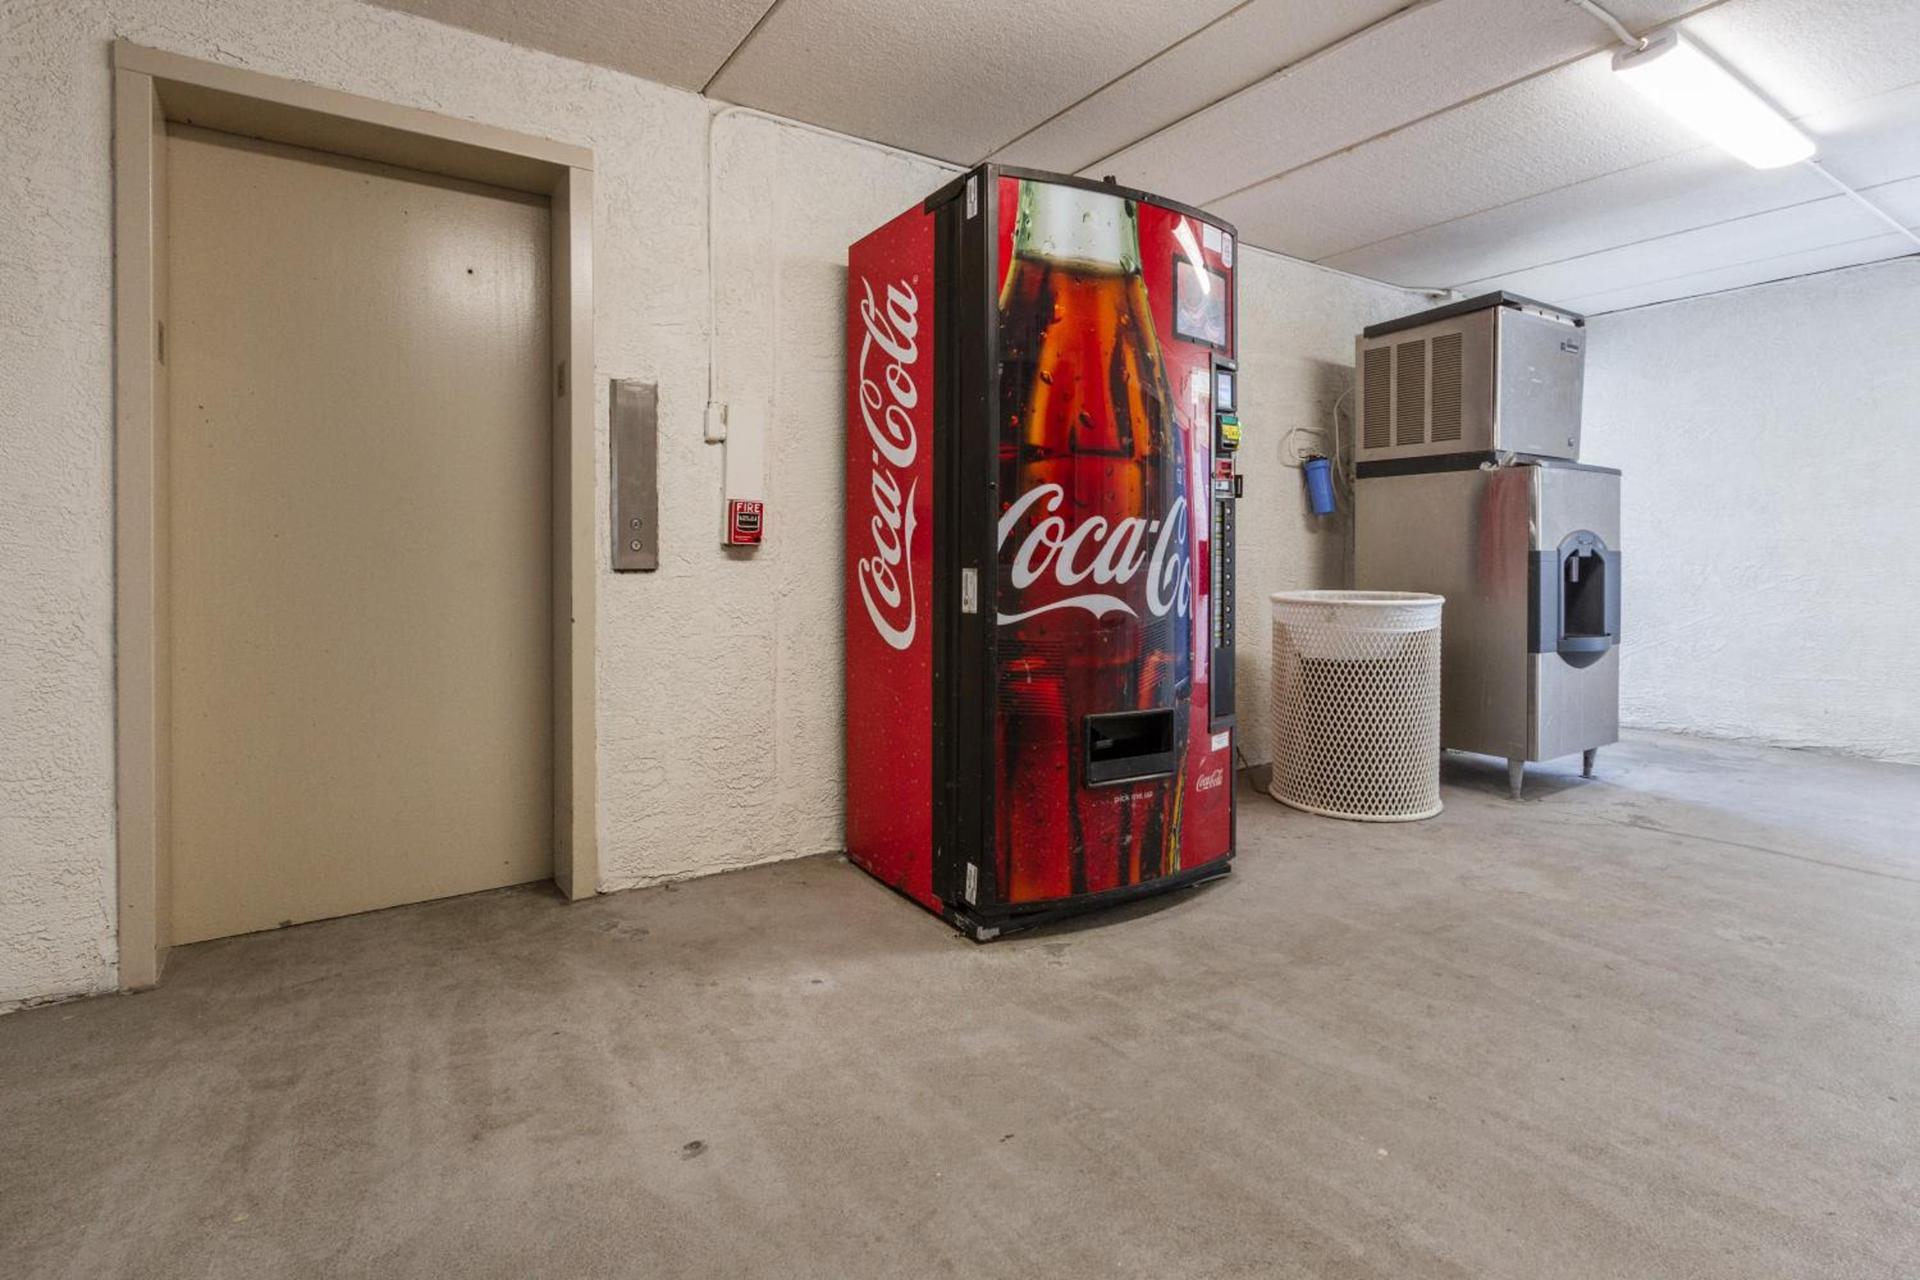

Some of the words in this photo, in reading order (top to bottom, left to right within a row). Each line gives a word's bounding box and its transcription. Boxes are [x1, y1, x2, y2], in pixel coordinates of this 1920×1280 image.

[859, 276, 918, 650] Coca-Cola
[736, 502, 760, 513] FIRE
[1113, 792, 1130, 804] pick
